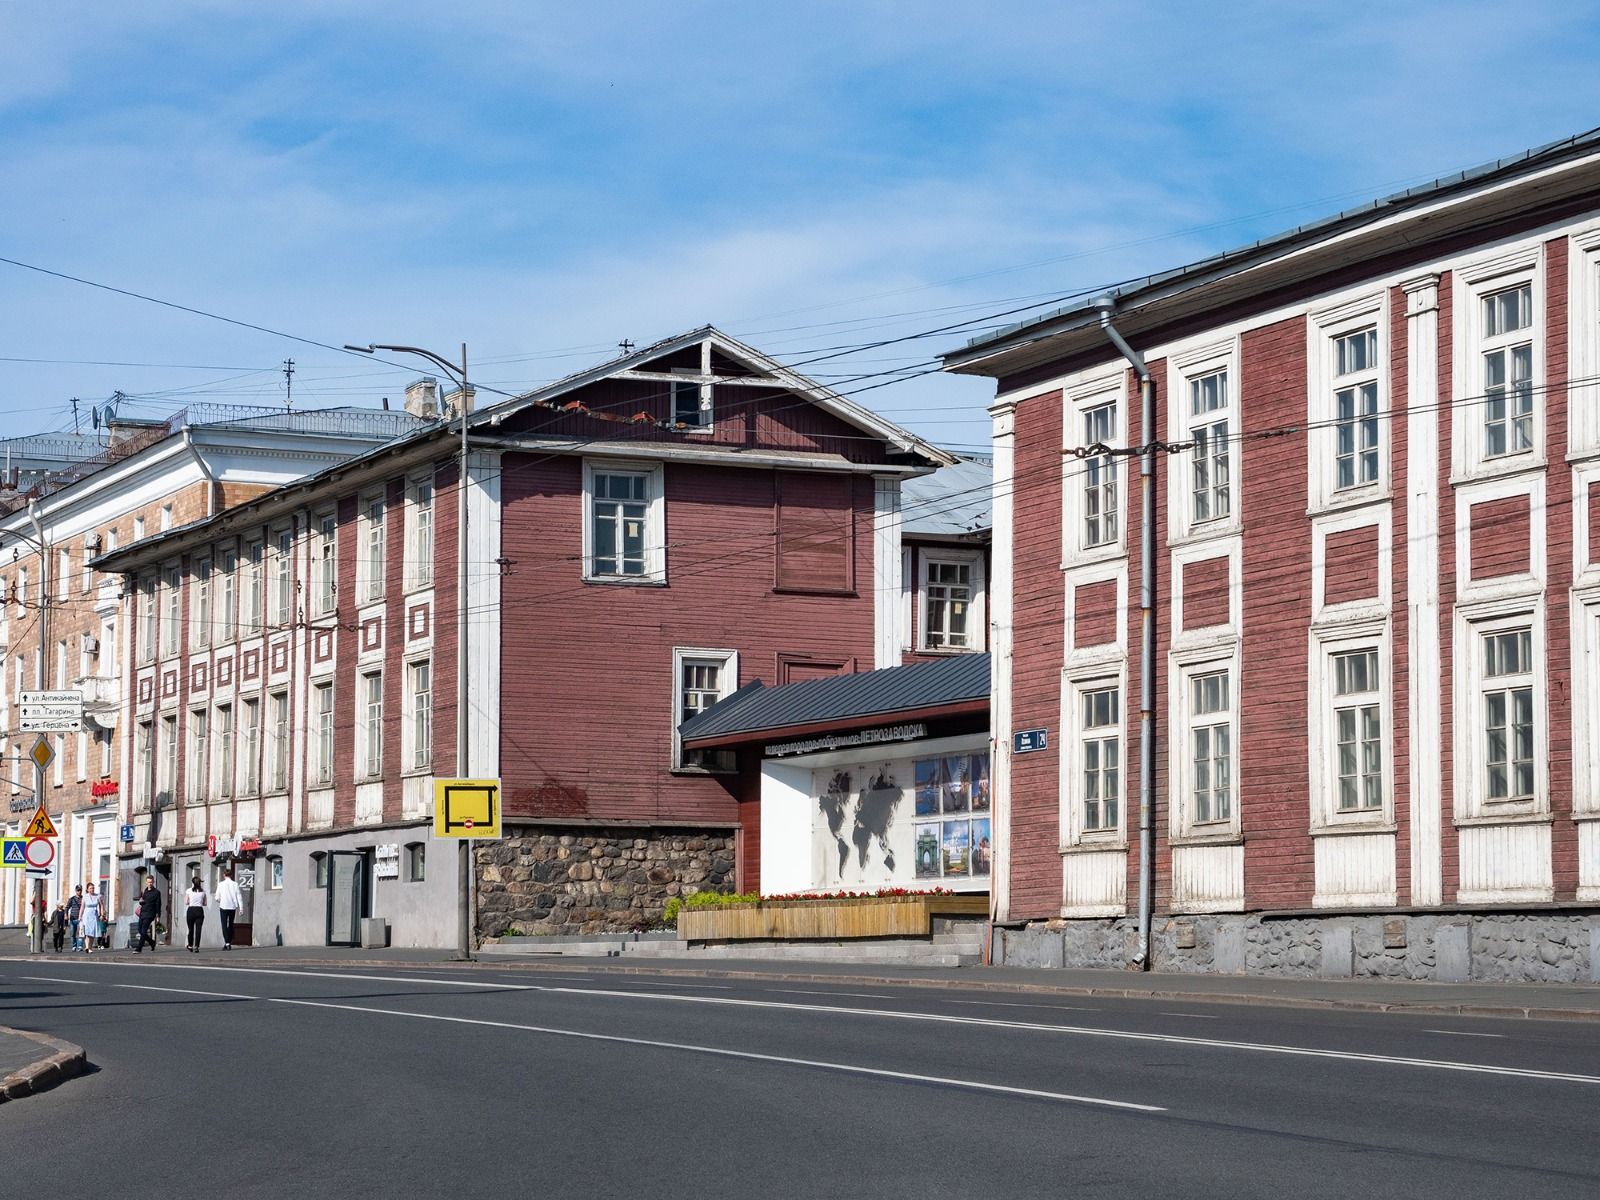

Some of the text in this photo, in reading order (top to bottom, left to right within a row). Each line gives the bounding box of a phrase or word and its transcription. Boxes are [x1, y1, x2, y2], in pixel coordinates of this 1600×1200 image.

[45, 707, 75, 716] Гагарина
[860, 723, 924, 743] ПЕТРОЗАВОДСКА
[239, 875, 254, 888] 24
